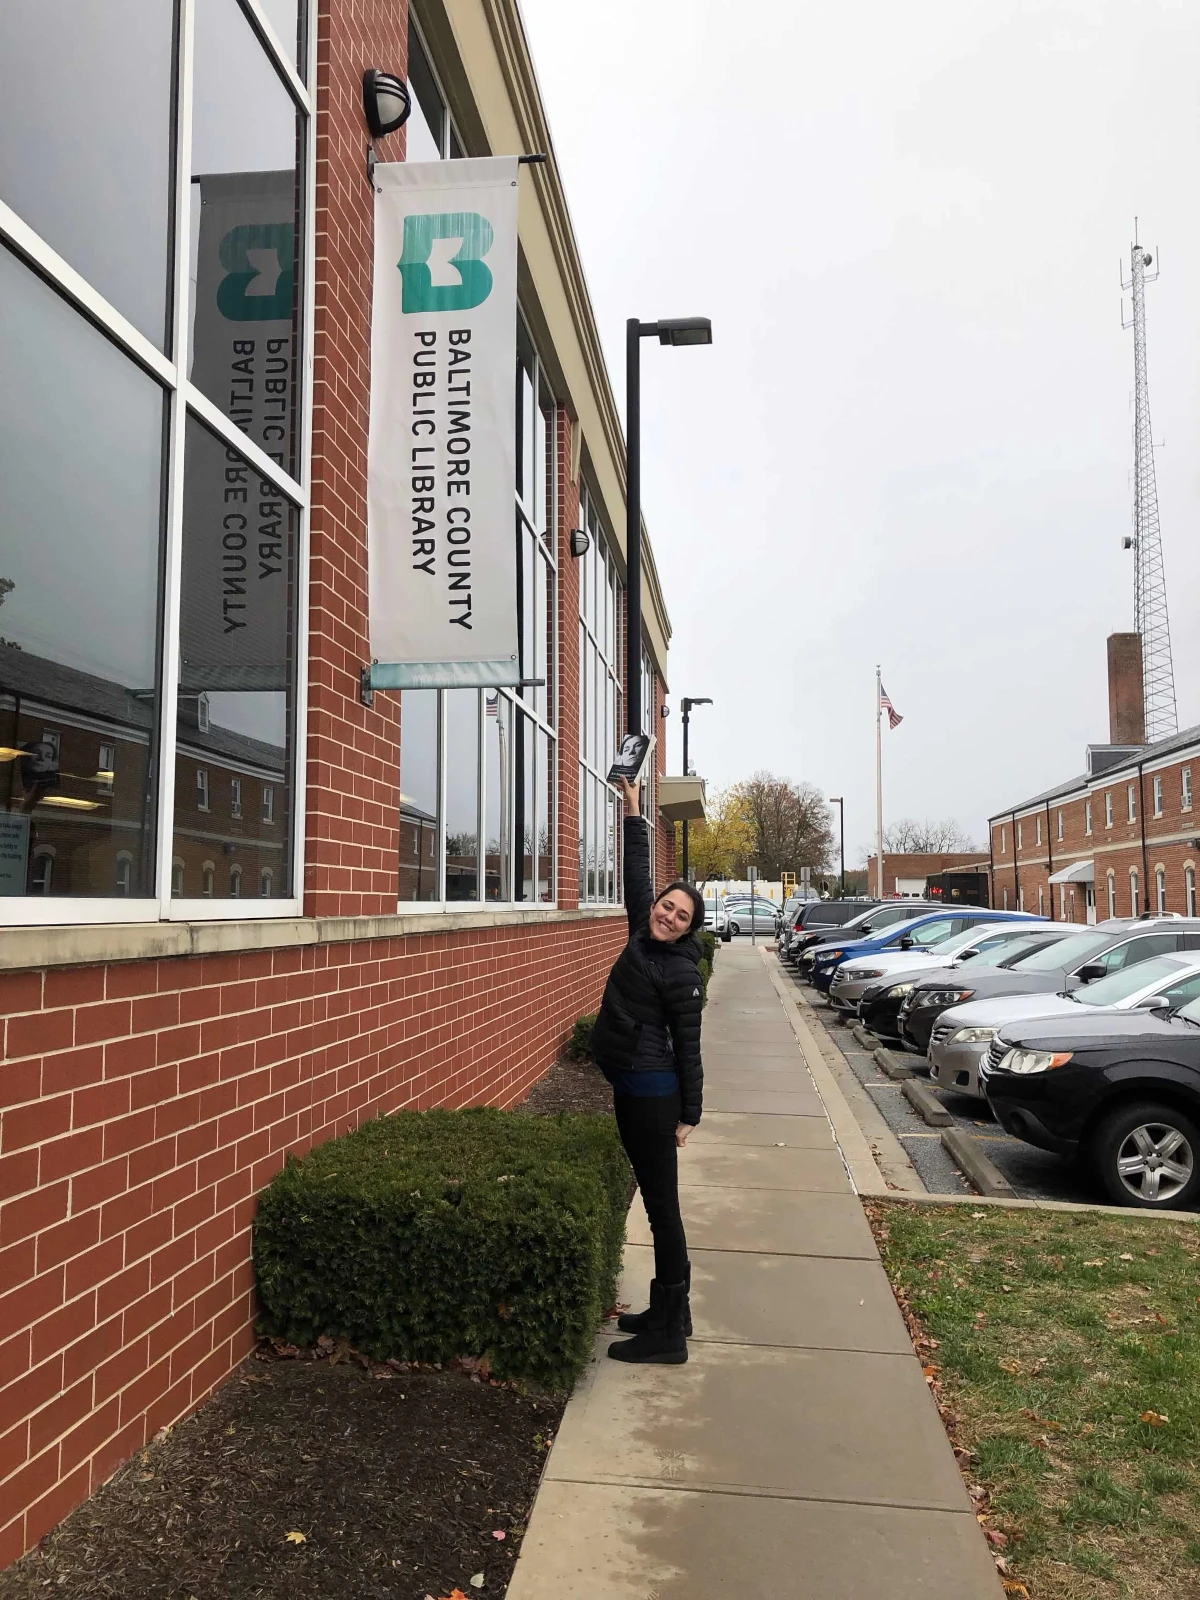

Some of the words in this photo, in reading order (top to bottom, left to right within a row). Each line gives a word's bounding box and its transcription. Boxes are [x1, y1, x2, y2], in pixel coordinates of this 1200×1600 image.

[411, 331, 437, 436] PUBLIC
[446, 329, 472, 497] BALTIMORE
[411, 447, 436, 576] LIBRARY
[446, 507, 473, 630] COUNTY
